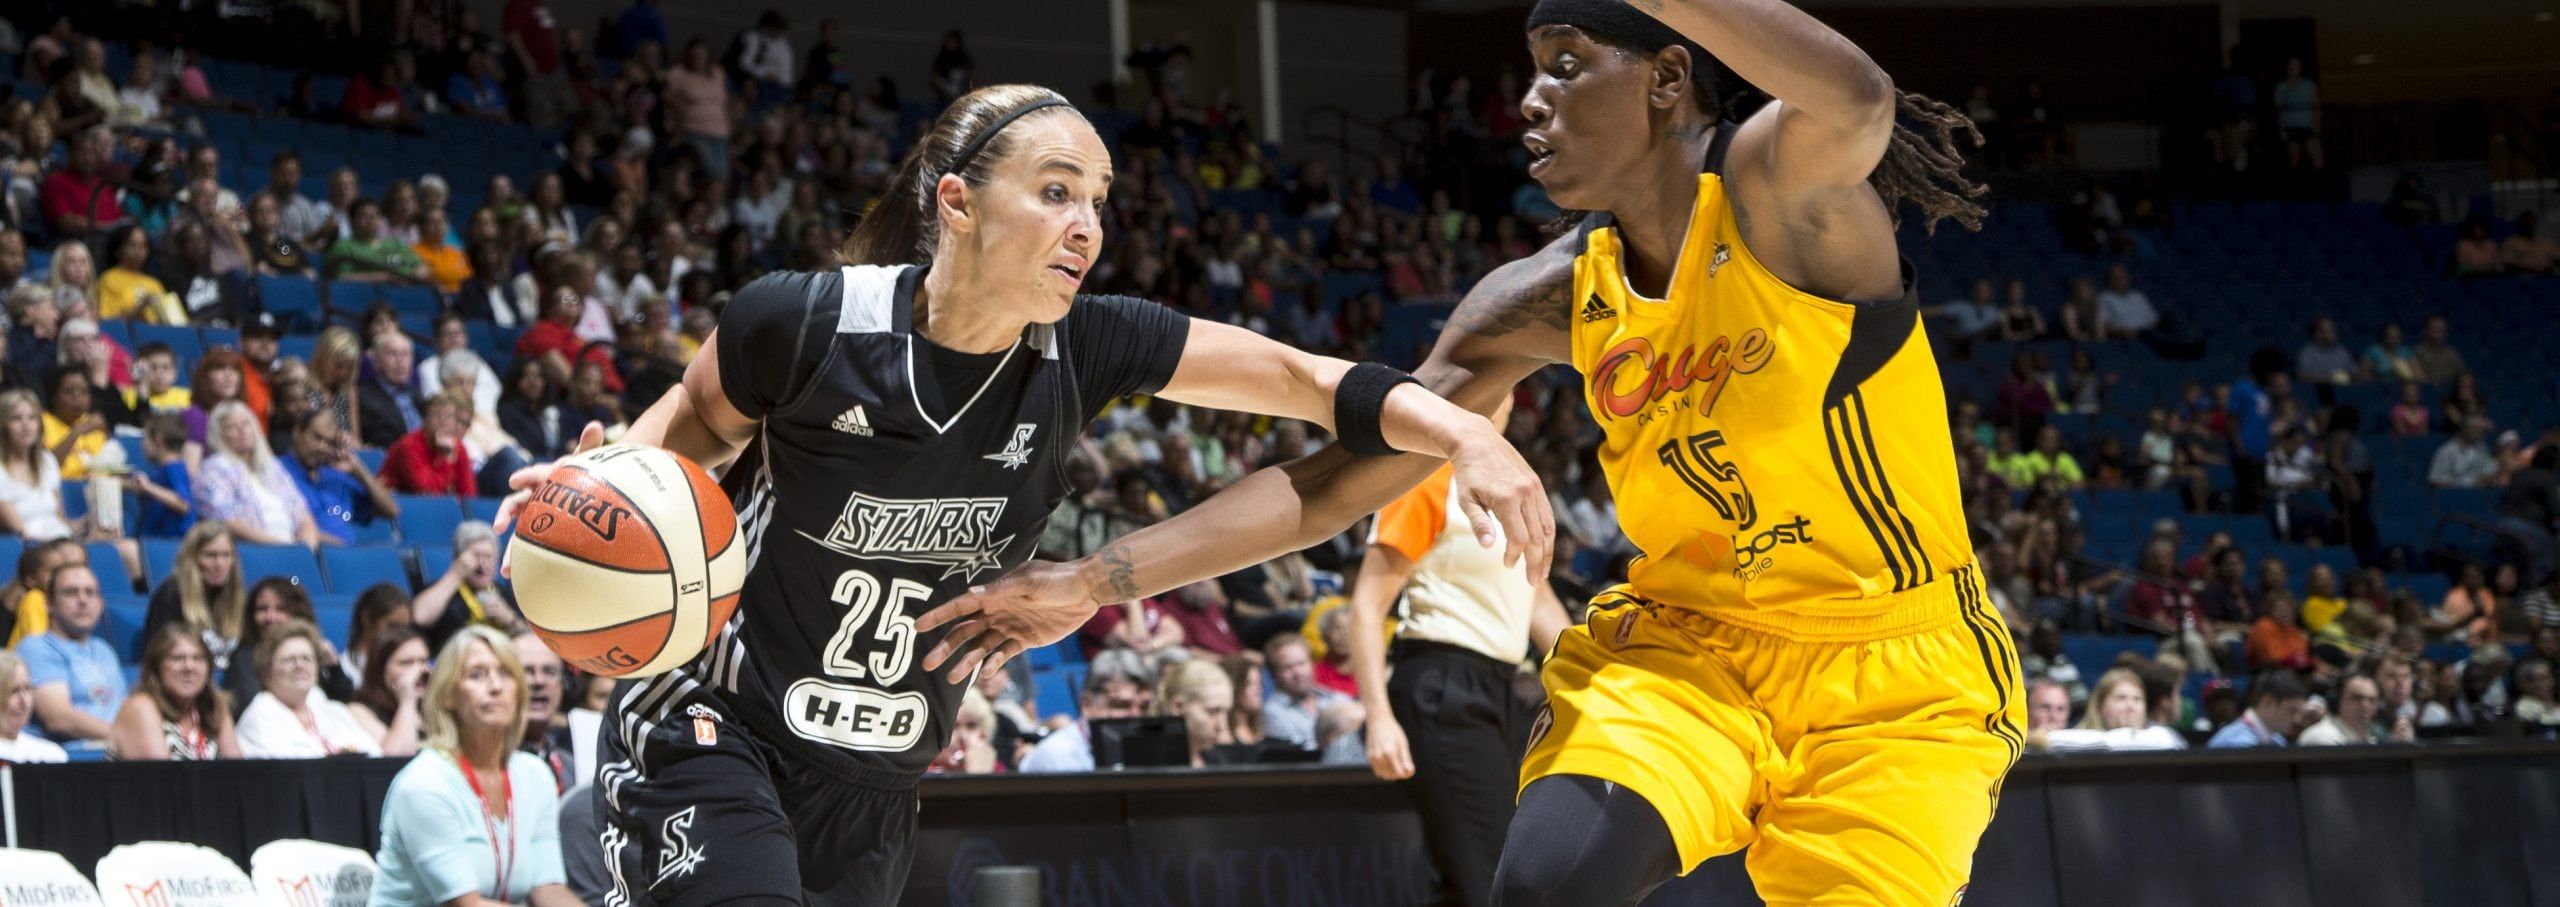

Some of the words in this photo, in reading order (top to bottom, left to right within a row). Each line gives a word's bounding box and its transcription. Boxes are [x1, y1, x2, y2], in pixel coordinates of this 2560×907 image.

[1585, 308, 1617, 323] adidas
[831, 420, 874, 437] adidas
[1638, 395, 1691, 426] CASIN
[1657, 430, 1757, 531] 15
[824, 491, 1008, 554] STARS
[823, 570, 933, 687] 25
[805, 695, 914, 737] H-E-B
